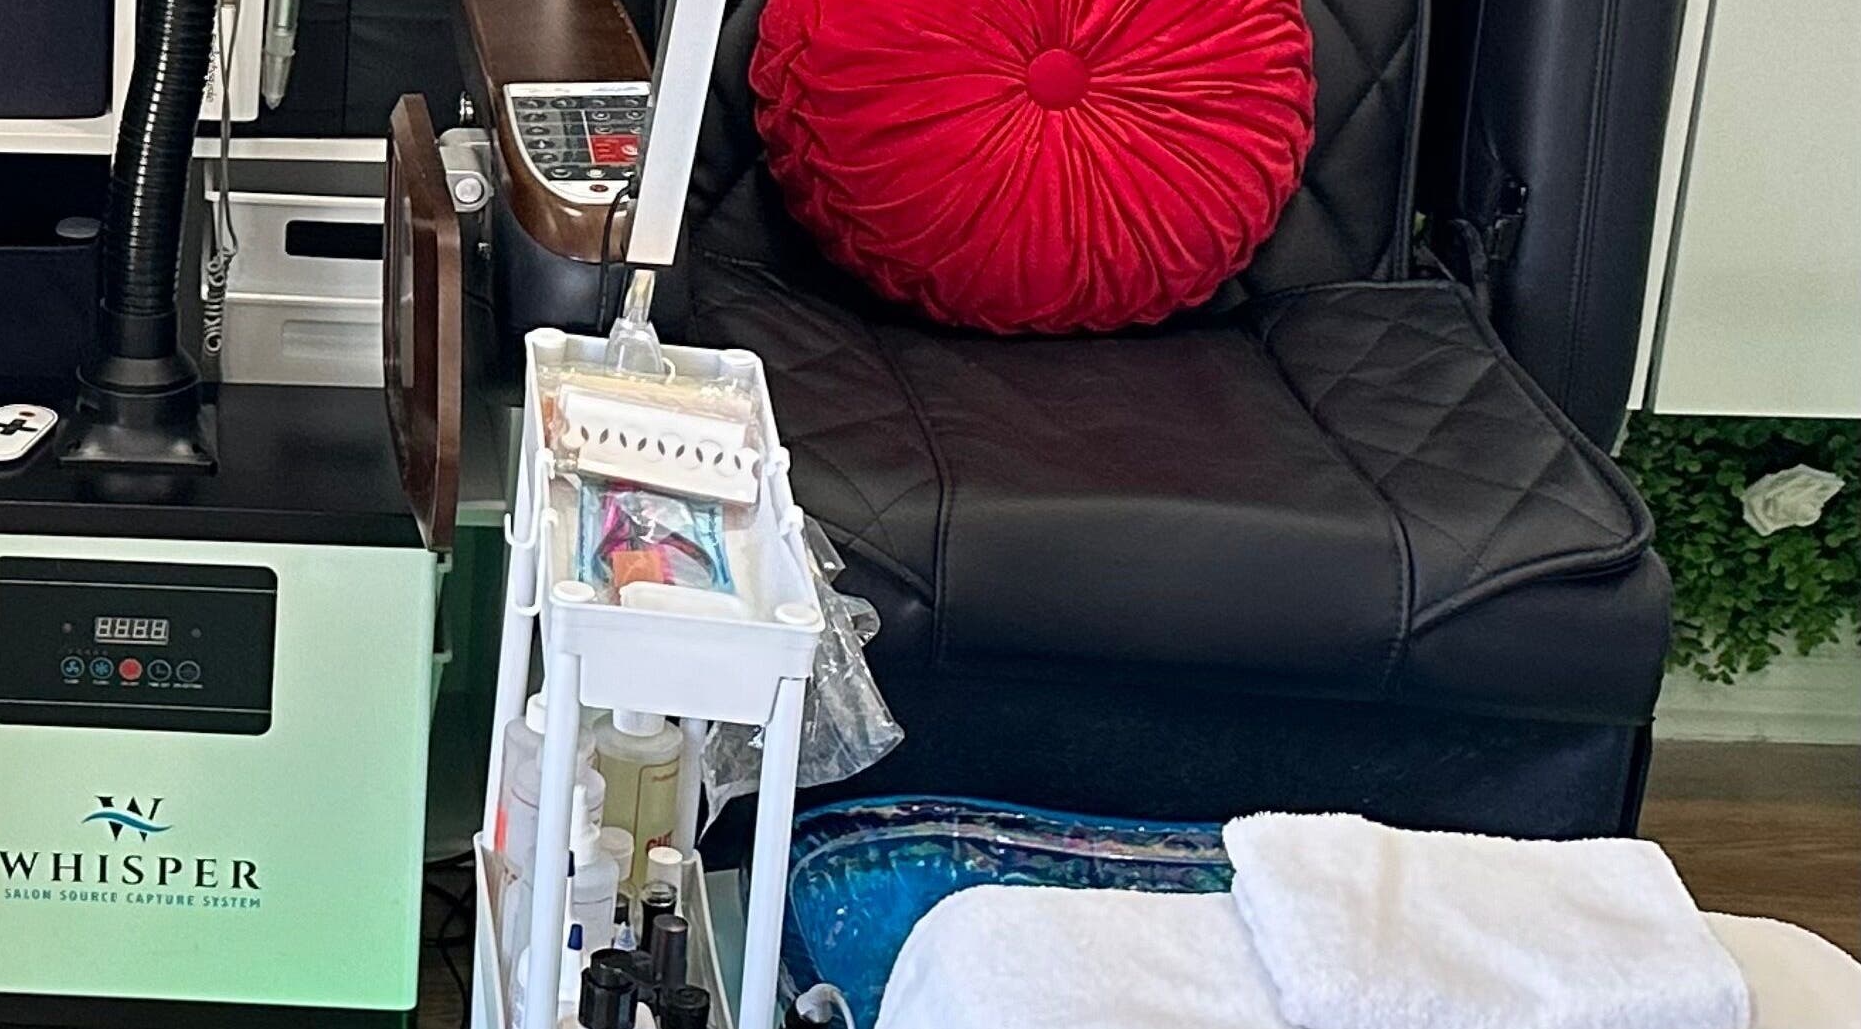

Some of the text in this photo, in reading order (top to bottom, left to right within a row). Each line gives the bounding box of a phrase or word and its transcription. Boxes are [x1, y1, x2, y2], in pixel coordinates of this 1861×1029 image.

[4, 888, 261, 909] SALON SOURCE CAPTURE SYSTEM
